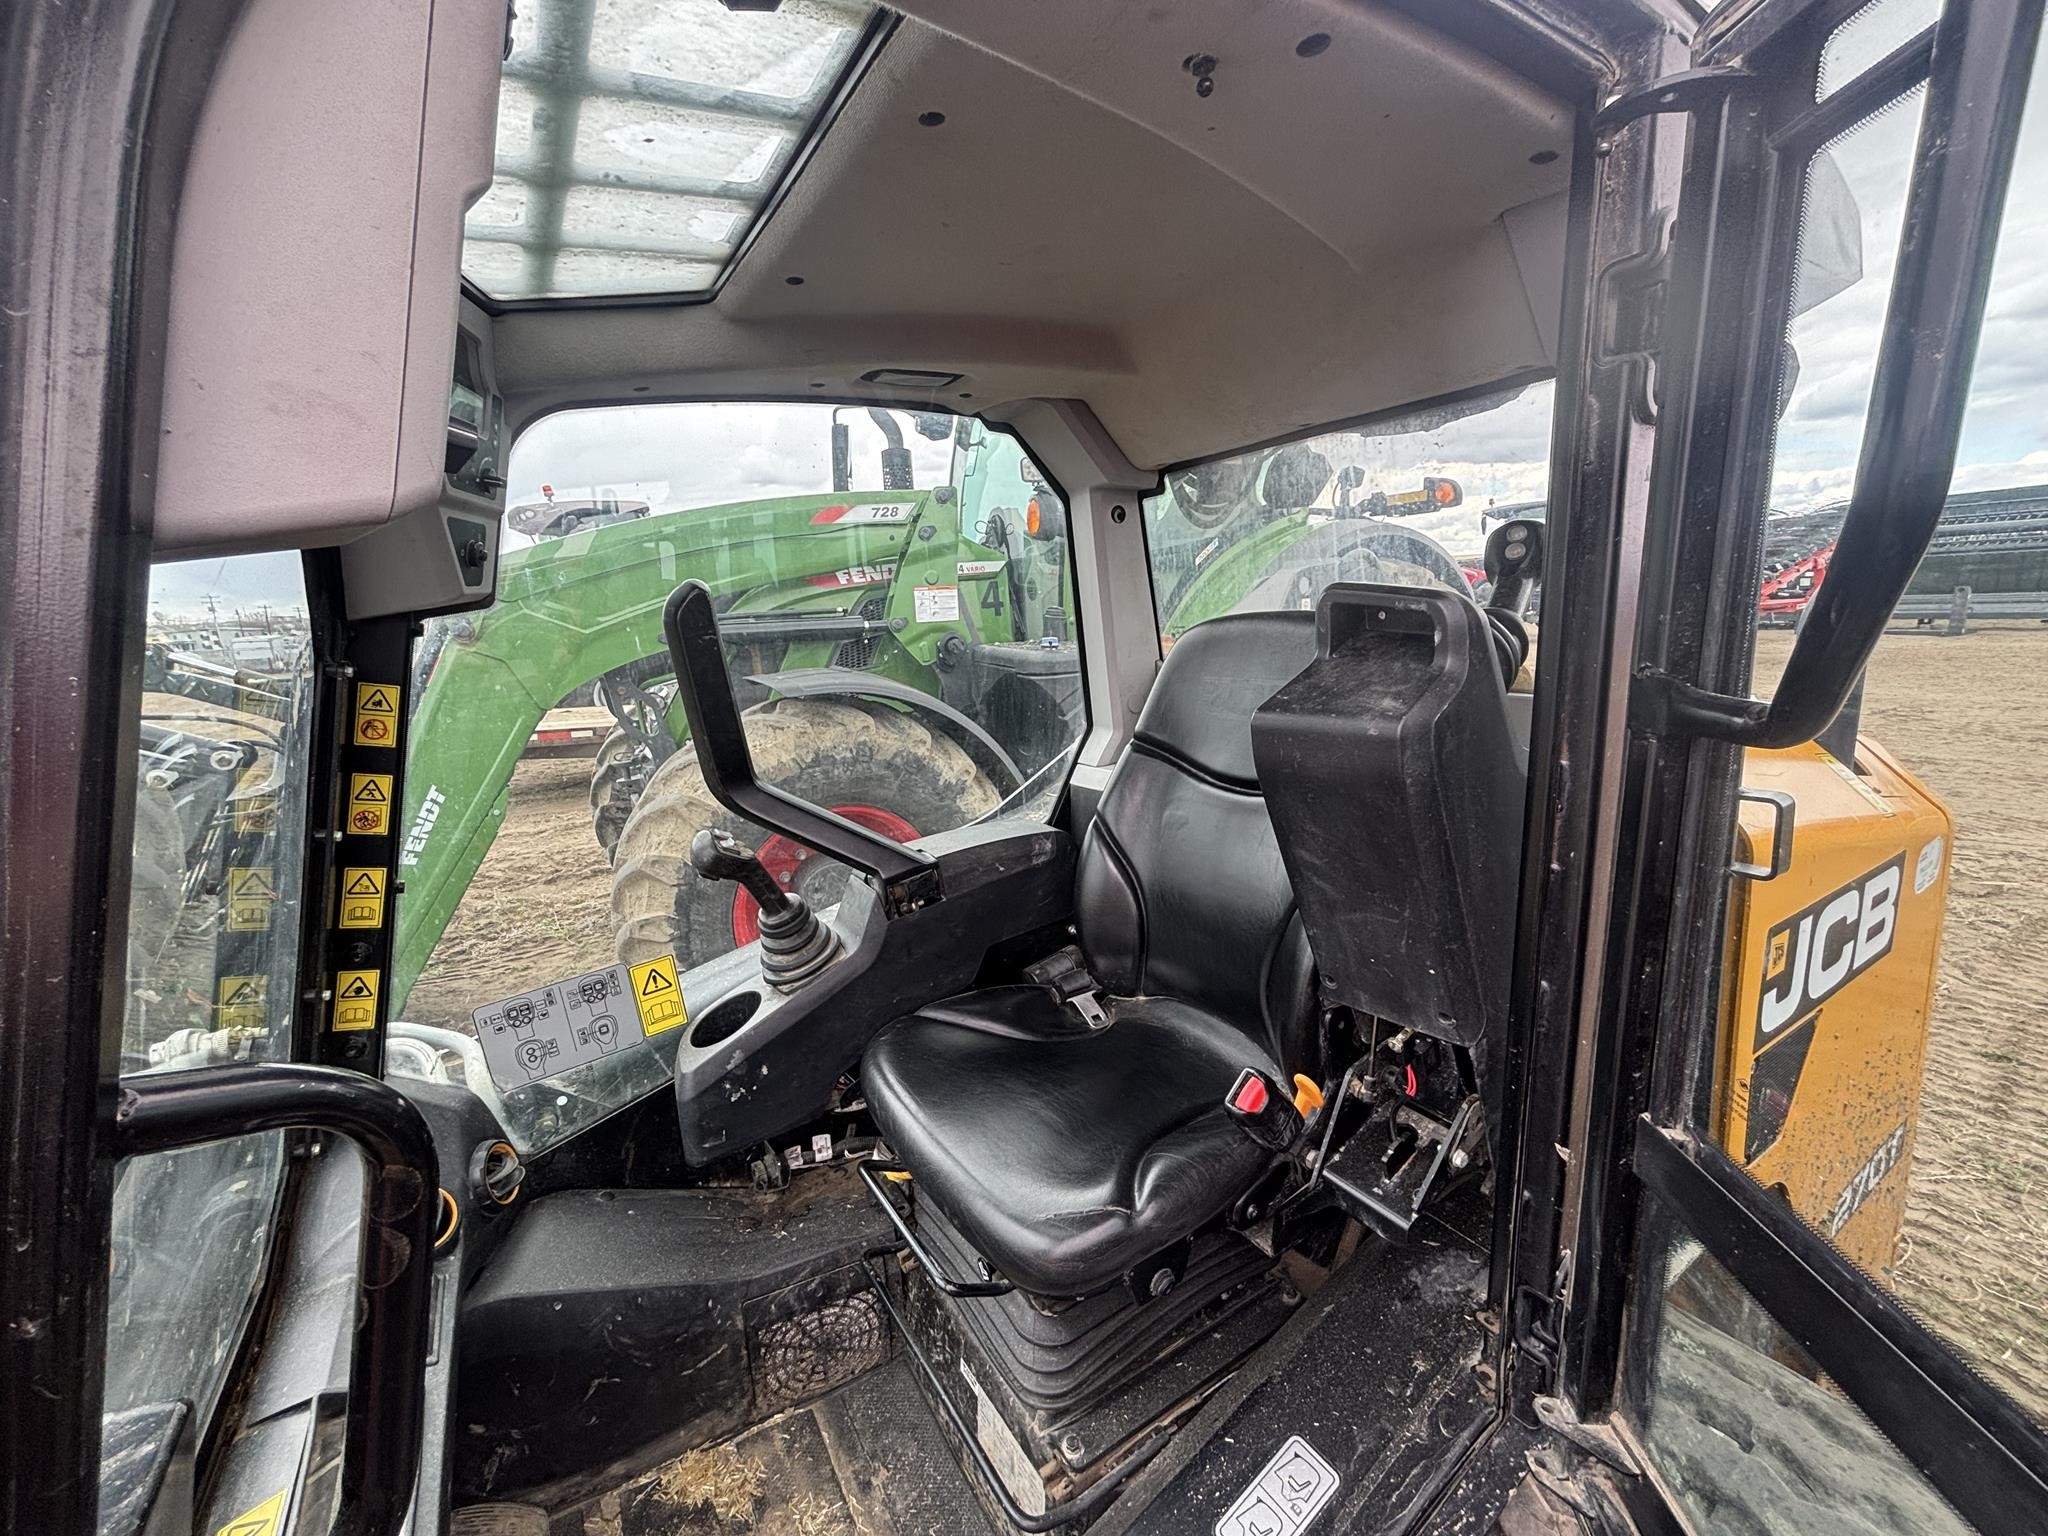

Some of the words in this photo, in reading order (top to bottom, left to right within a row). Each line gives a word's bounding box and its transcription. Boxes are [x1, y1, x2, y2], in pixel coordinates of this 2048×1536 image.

[871, 506, 899, 519] 728
[835, 564, 898, 585] FEND
[981, 581, 1004, 617] 4
[399, 784, 446, 866] FENDT
[1761, 865, 1900, 1033] JCB
[1832, 1122, 1905, 1240] 270T
